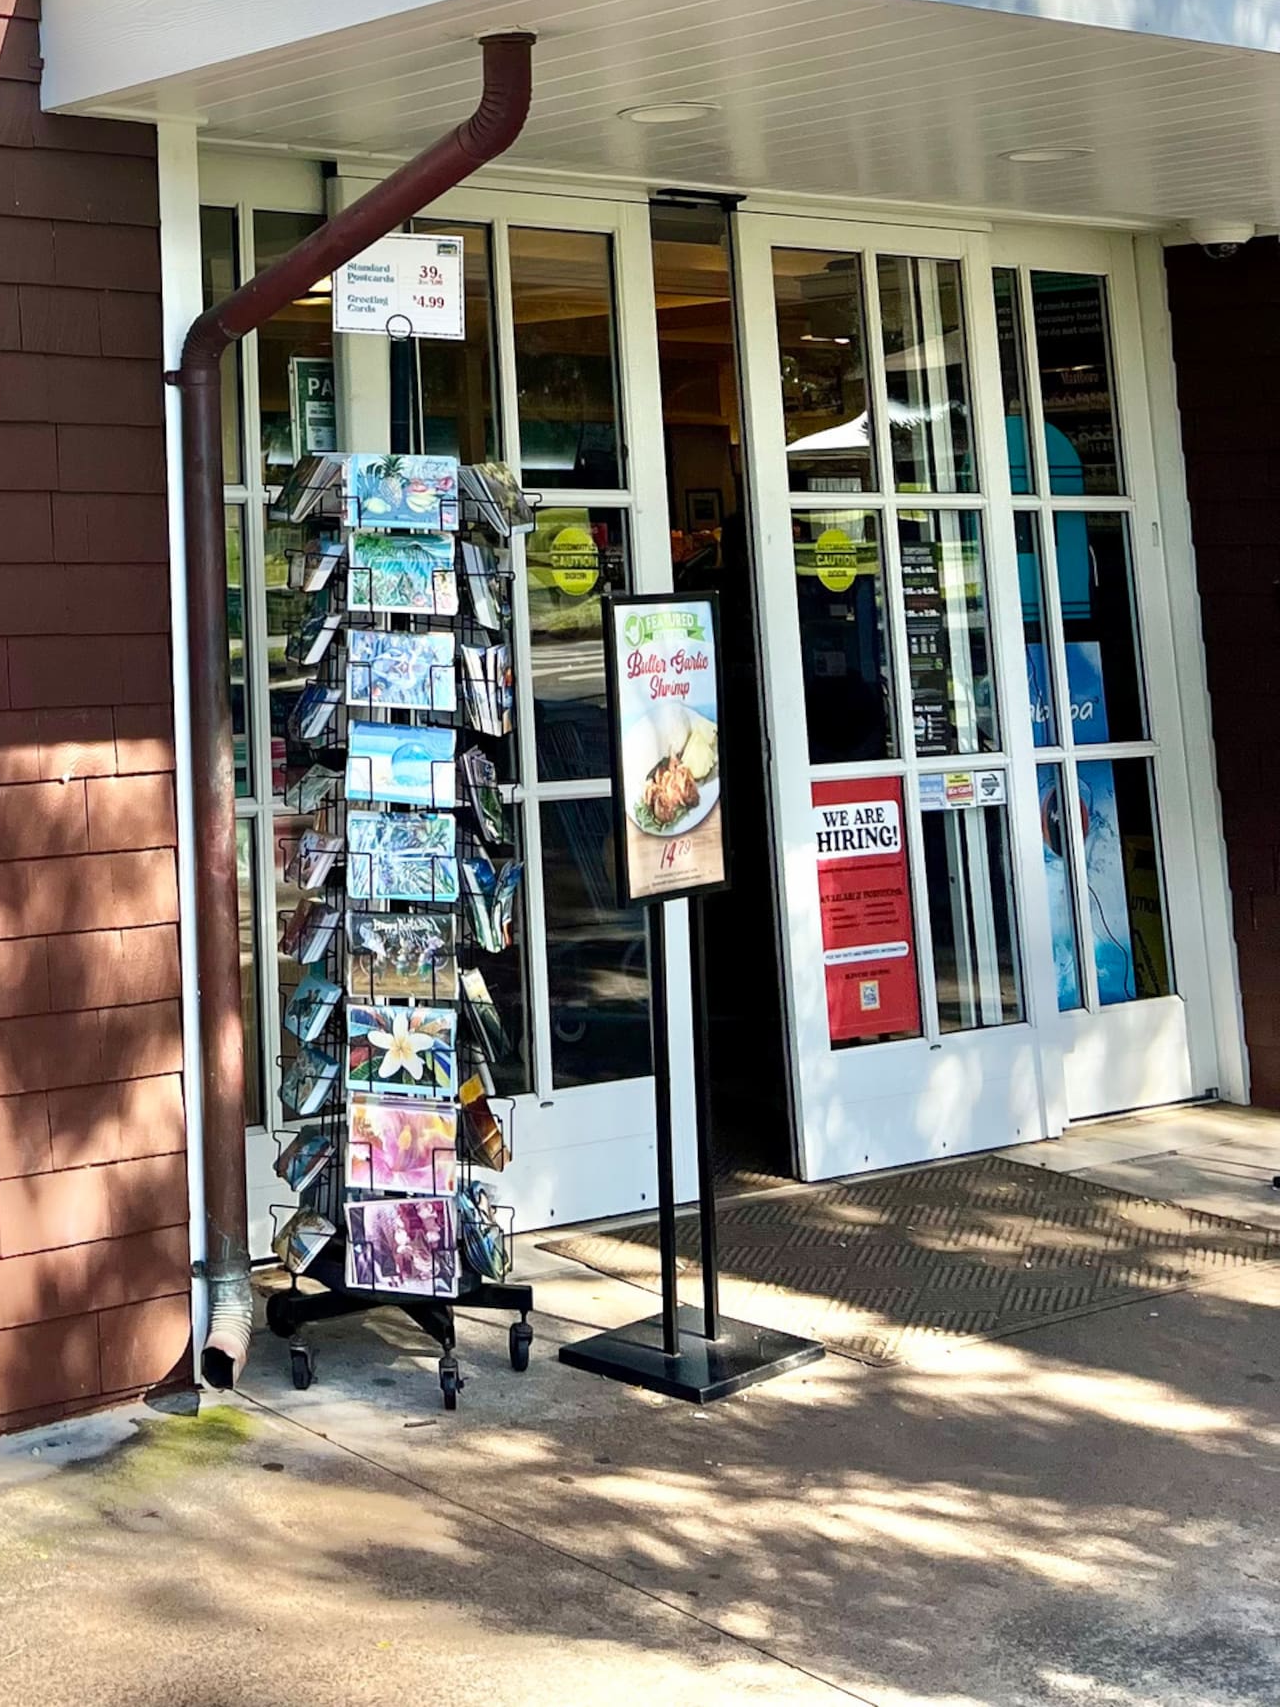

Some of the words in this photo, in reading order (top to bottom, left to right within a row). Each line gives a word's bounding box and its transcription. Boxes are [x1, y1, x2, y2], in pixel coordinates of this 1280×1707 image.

[347, 263, 390, 273] Standard
[347, 273, 395, 283] Postcards
[347, 294, 389, 306] Greeting
[413, 295, 445, 309] $4.99
[347, 304, 376, 313] Cards
[816, 554, 856, 566] CAUTION
[645, 613, 695, 630] FEATURED
[627, 649, 667, 679] Butter
[670, 648, 709, 674] Garlic
[649, 675, 690, 700] Shrimp
[822, 809, 849, 828] WE
[854, 807, 885, 825] ARE
[816, 825, 898, 853] HIRING!
